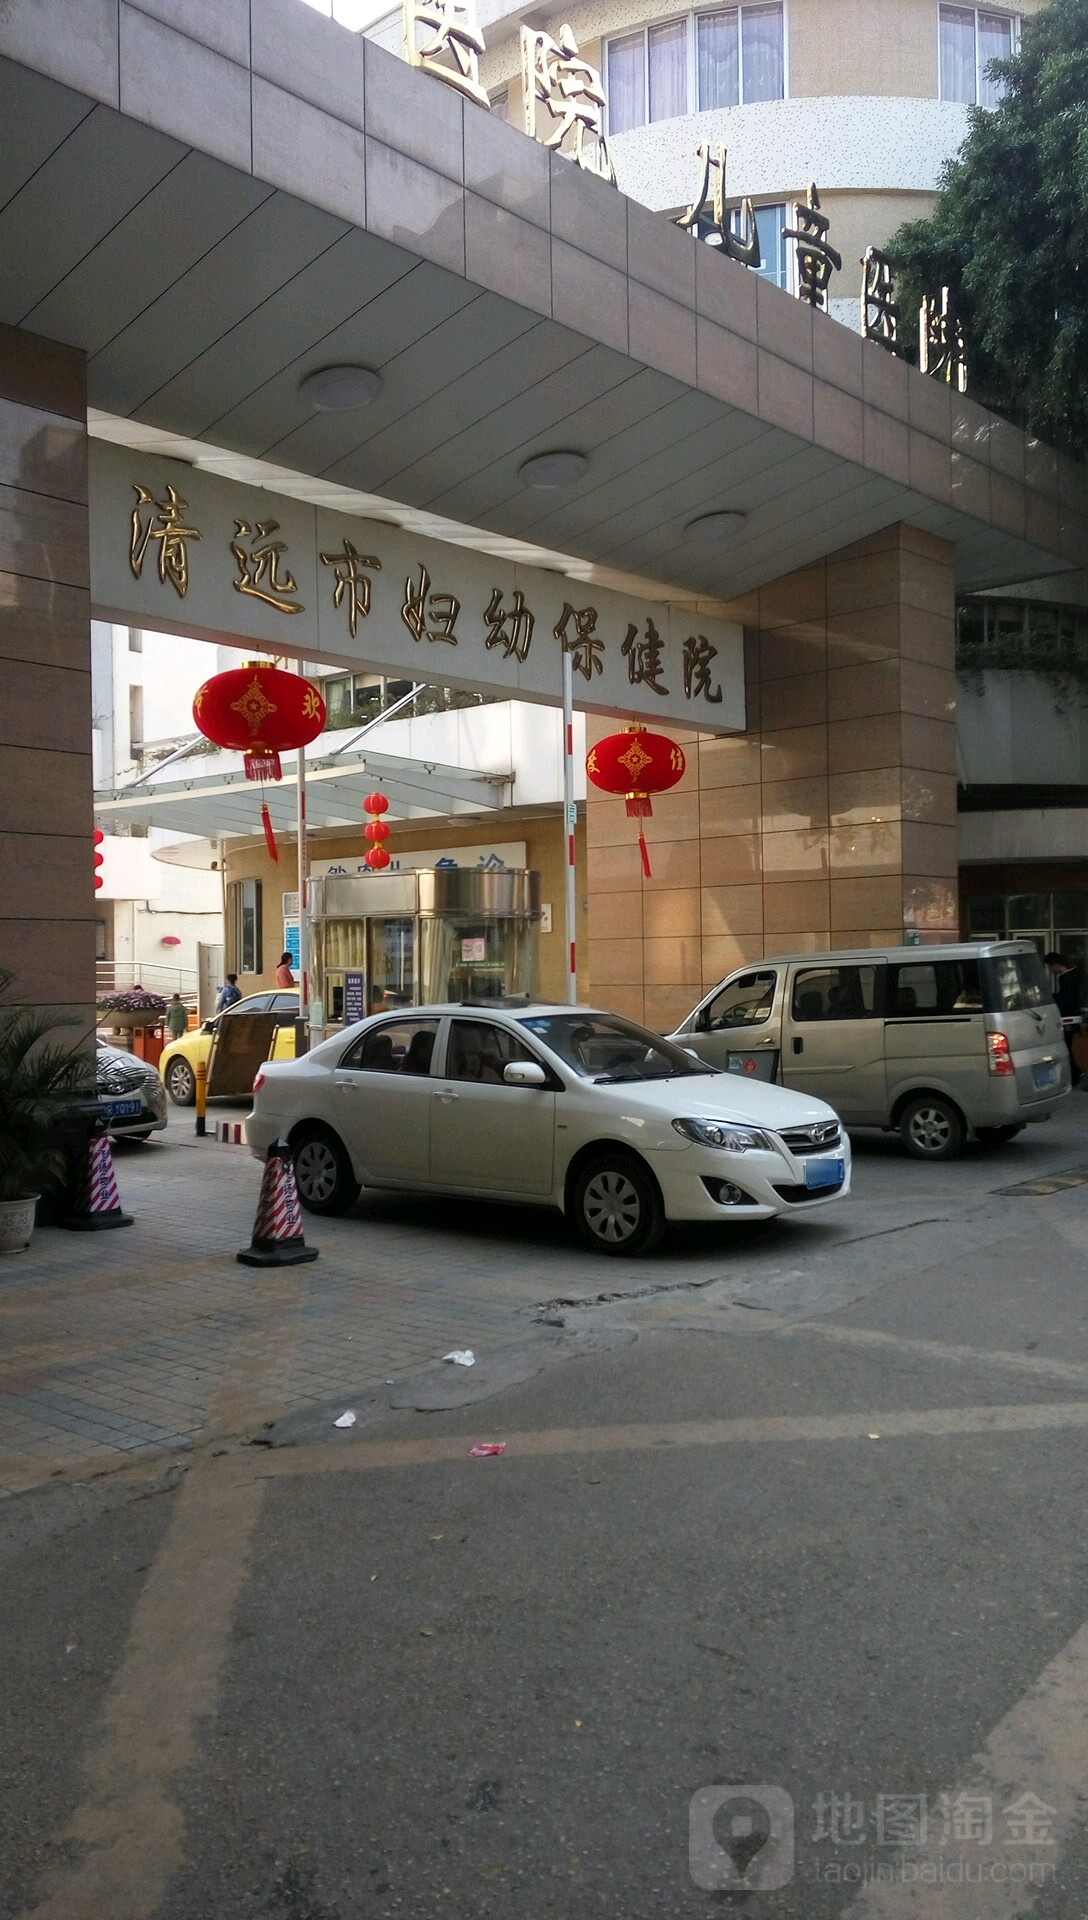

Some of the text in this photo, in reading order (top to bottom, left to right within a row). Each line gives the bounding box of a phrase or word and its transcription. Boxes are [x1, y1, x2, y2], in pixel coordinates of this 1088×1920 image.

[130, 484, 723, 704] 清远市妇幼保健院
